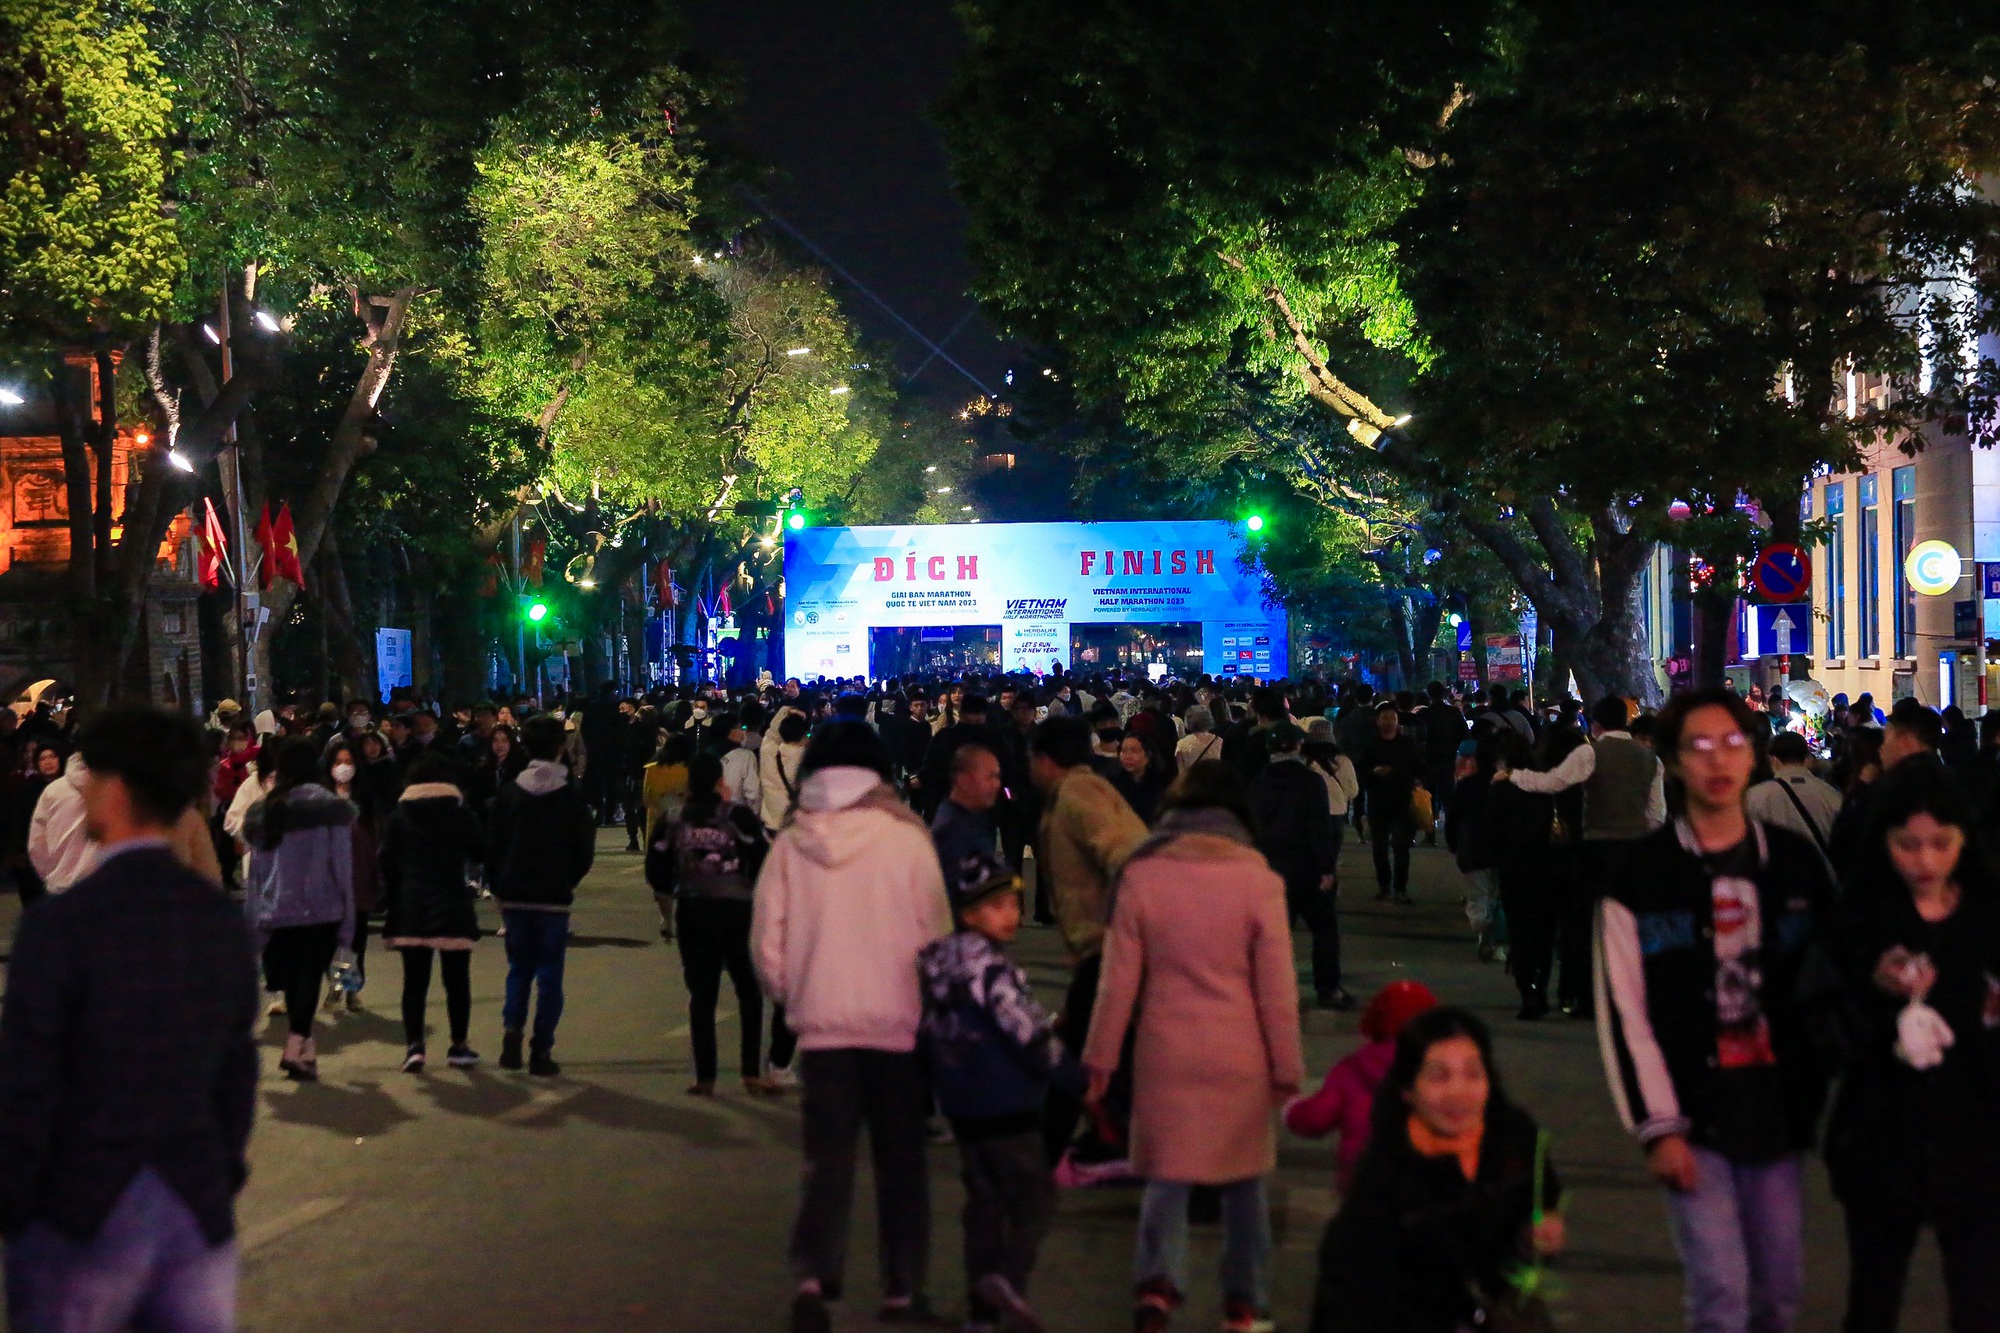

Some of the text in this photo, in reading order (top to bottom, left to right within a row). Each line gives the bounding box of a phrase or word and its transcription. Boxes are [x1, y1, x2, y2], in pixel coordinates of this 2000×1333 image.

[874, 551, 978, 581] ĐÍCH
[1080, 550, 1215, 575] FINISH
[1129, 587, 1192, 595] INTERNATIONAL
[1006, 598, 1068, 609] VIETNAM
